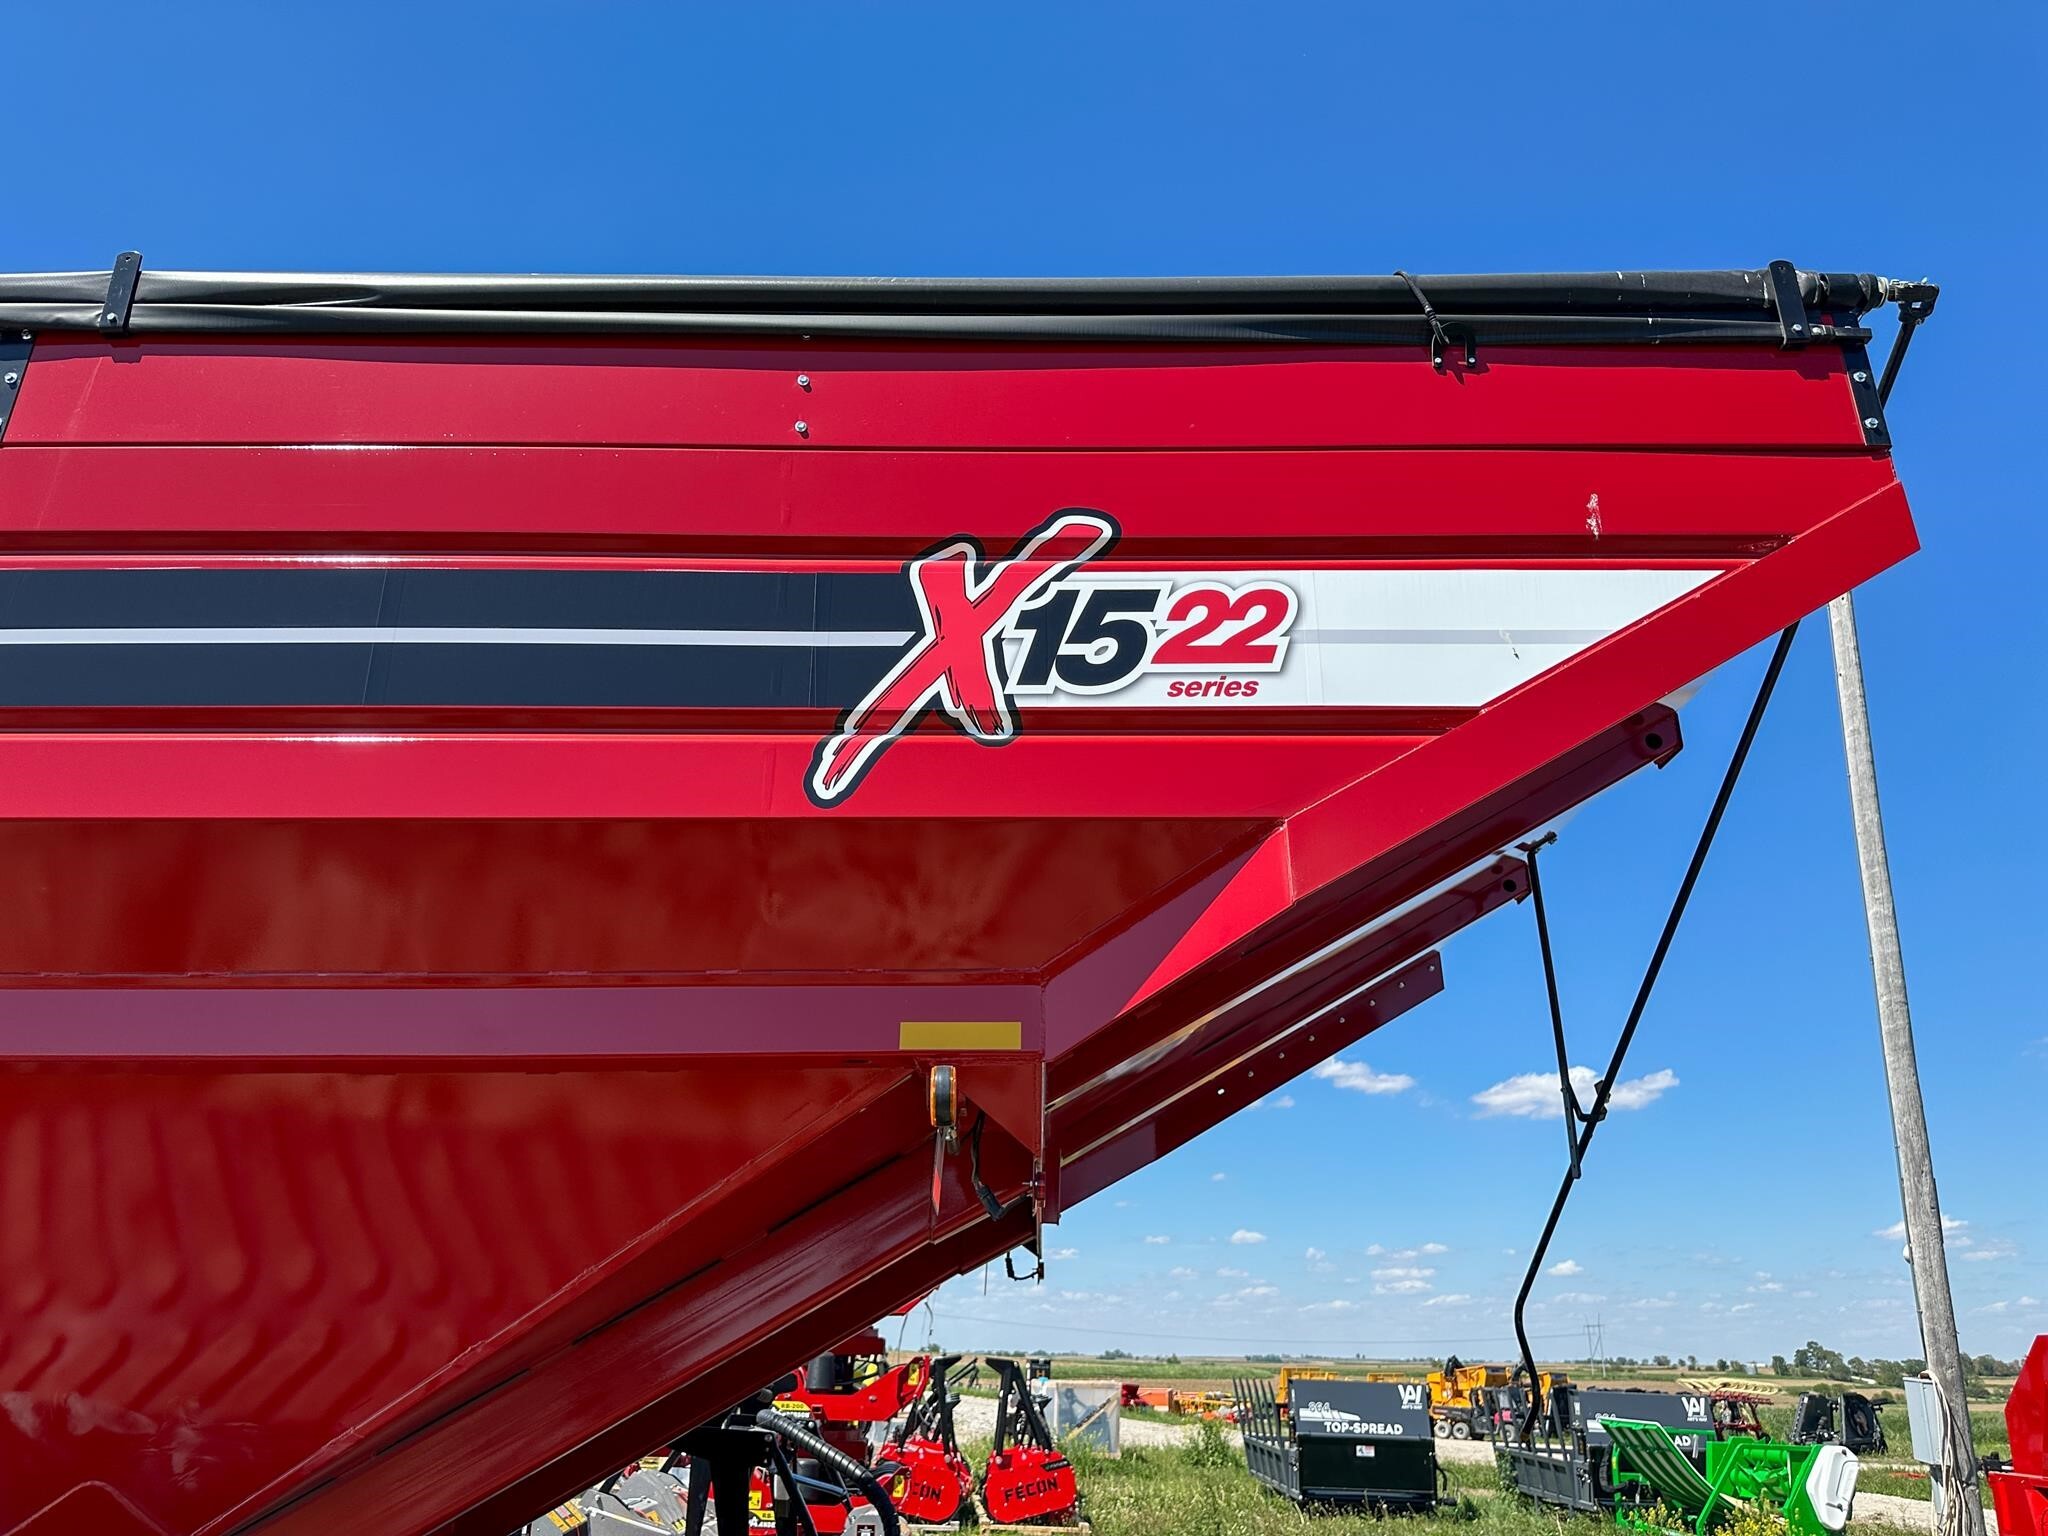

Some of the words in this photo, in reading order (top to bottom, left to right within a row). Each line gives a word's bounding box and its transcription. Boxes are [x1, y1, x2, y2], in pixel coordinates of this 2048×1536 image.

[1167, 676, 1259, 698] series
[1323, 1421, 1404, 1435] TOP-SPREAD
[1004, 1477, 1058, 1503] FECON
